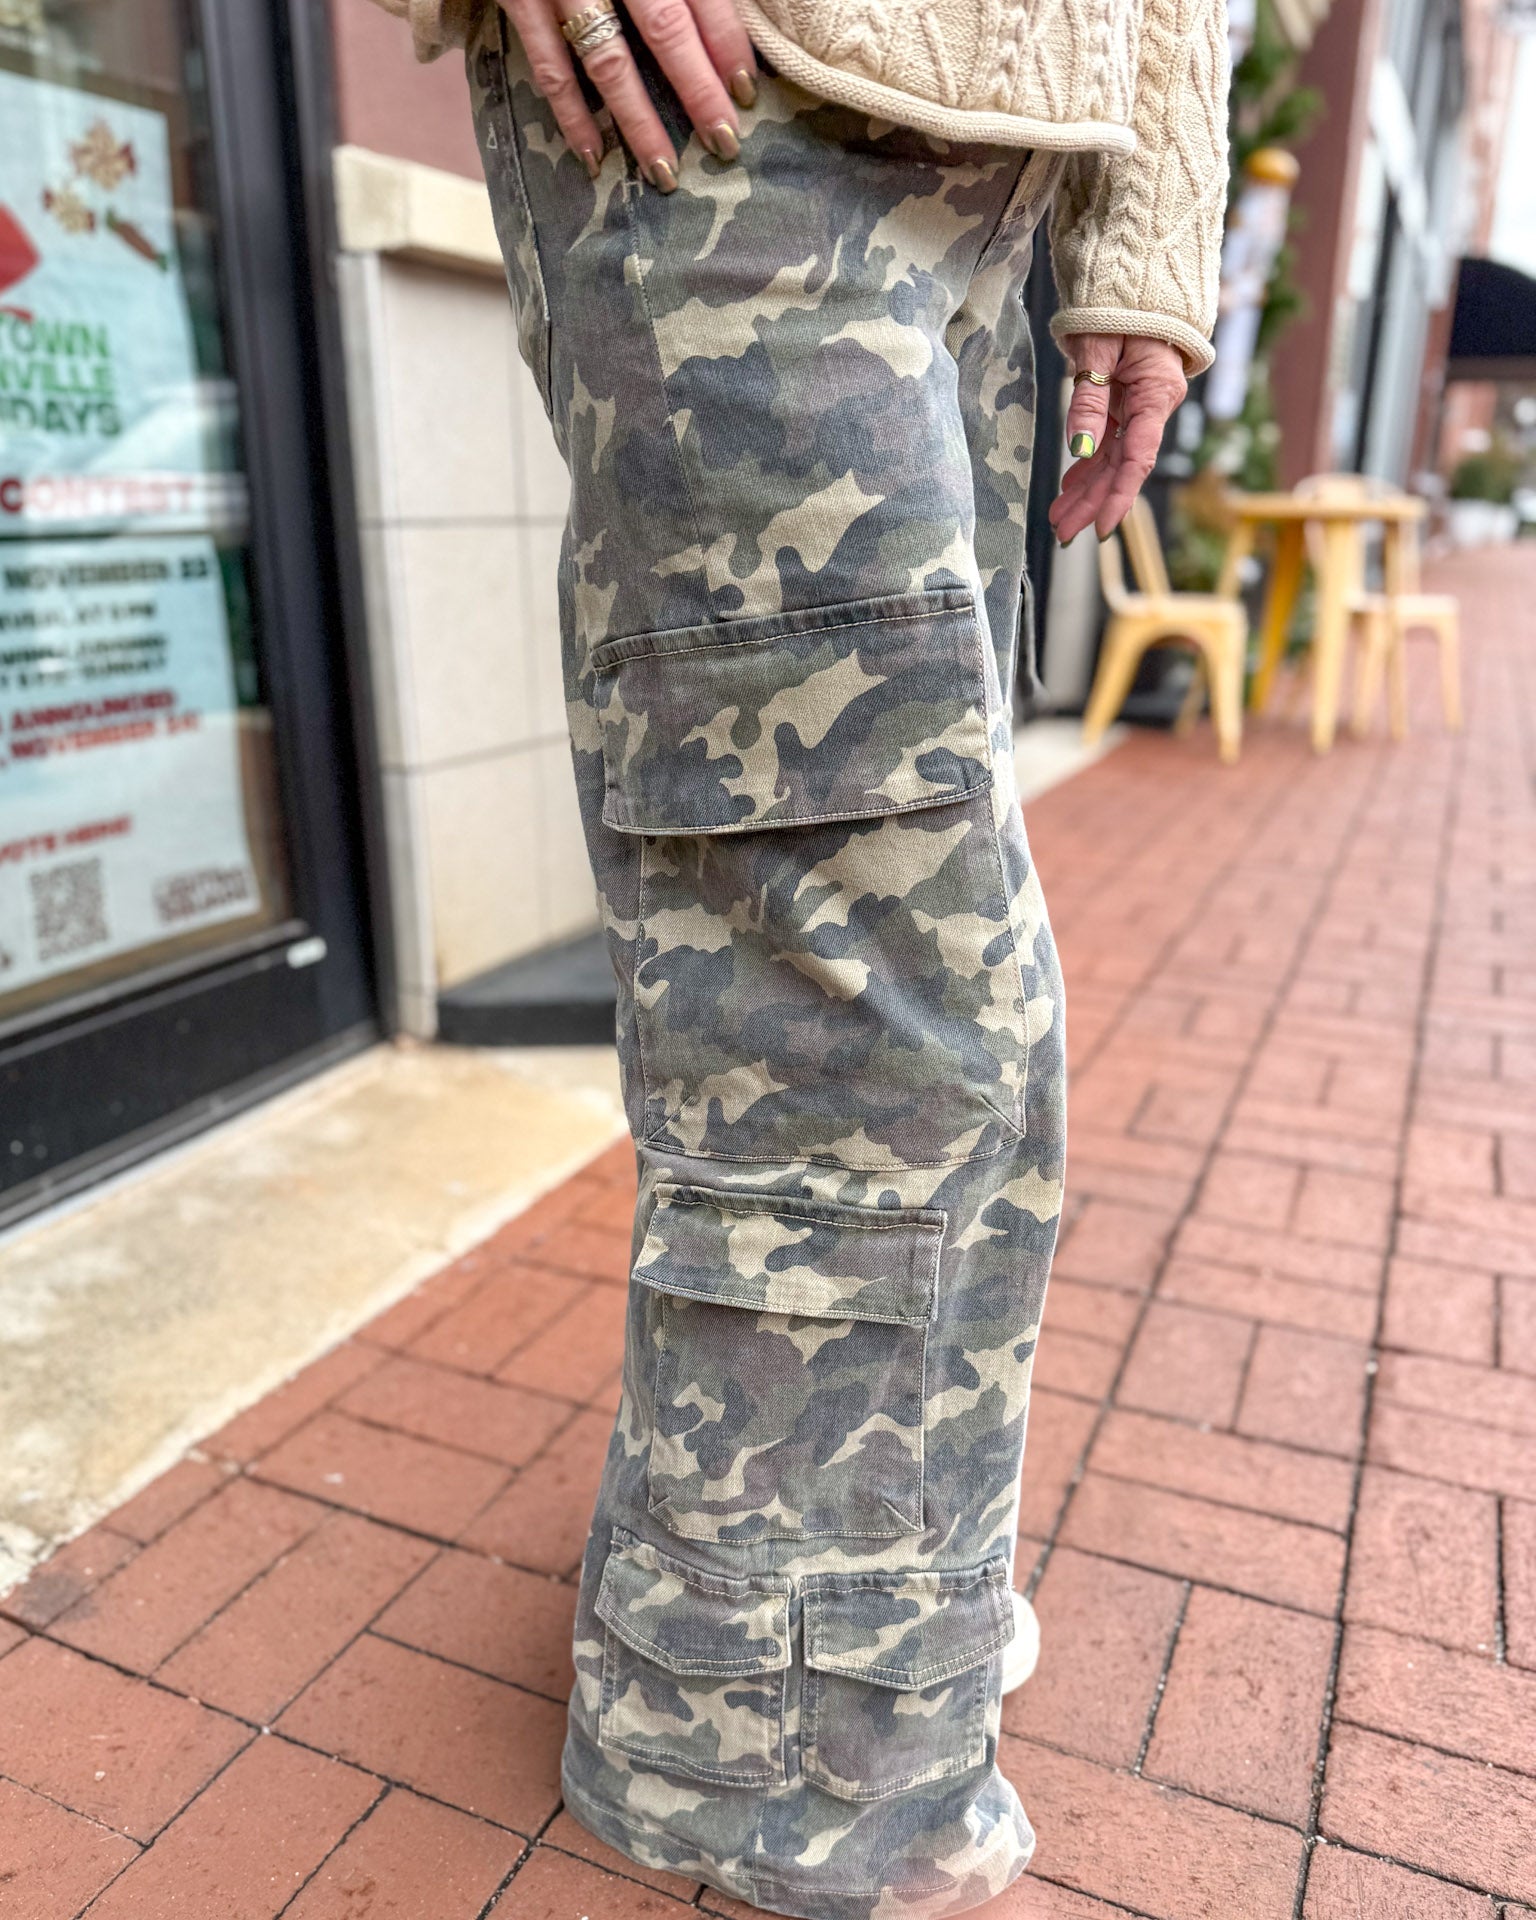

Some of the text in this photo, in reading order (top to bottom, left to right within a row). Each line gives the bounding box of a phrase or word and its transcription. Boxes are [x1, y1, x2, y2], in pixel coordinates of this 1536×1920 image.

[0, 312, 109, 357] OWN
[0, 478, 192, 513] CONTEST
[4, 560, 168, 588] NOVEMBER
[12, 690, 176, 730] ANNOUNCED
[11, 721, 155, 756] NOVEMBER
